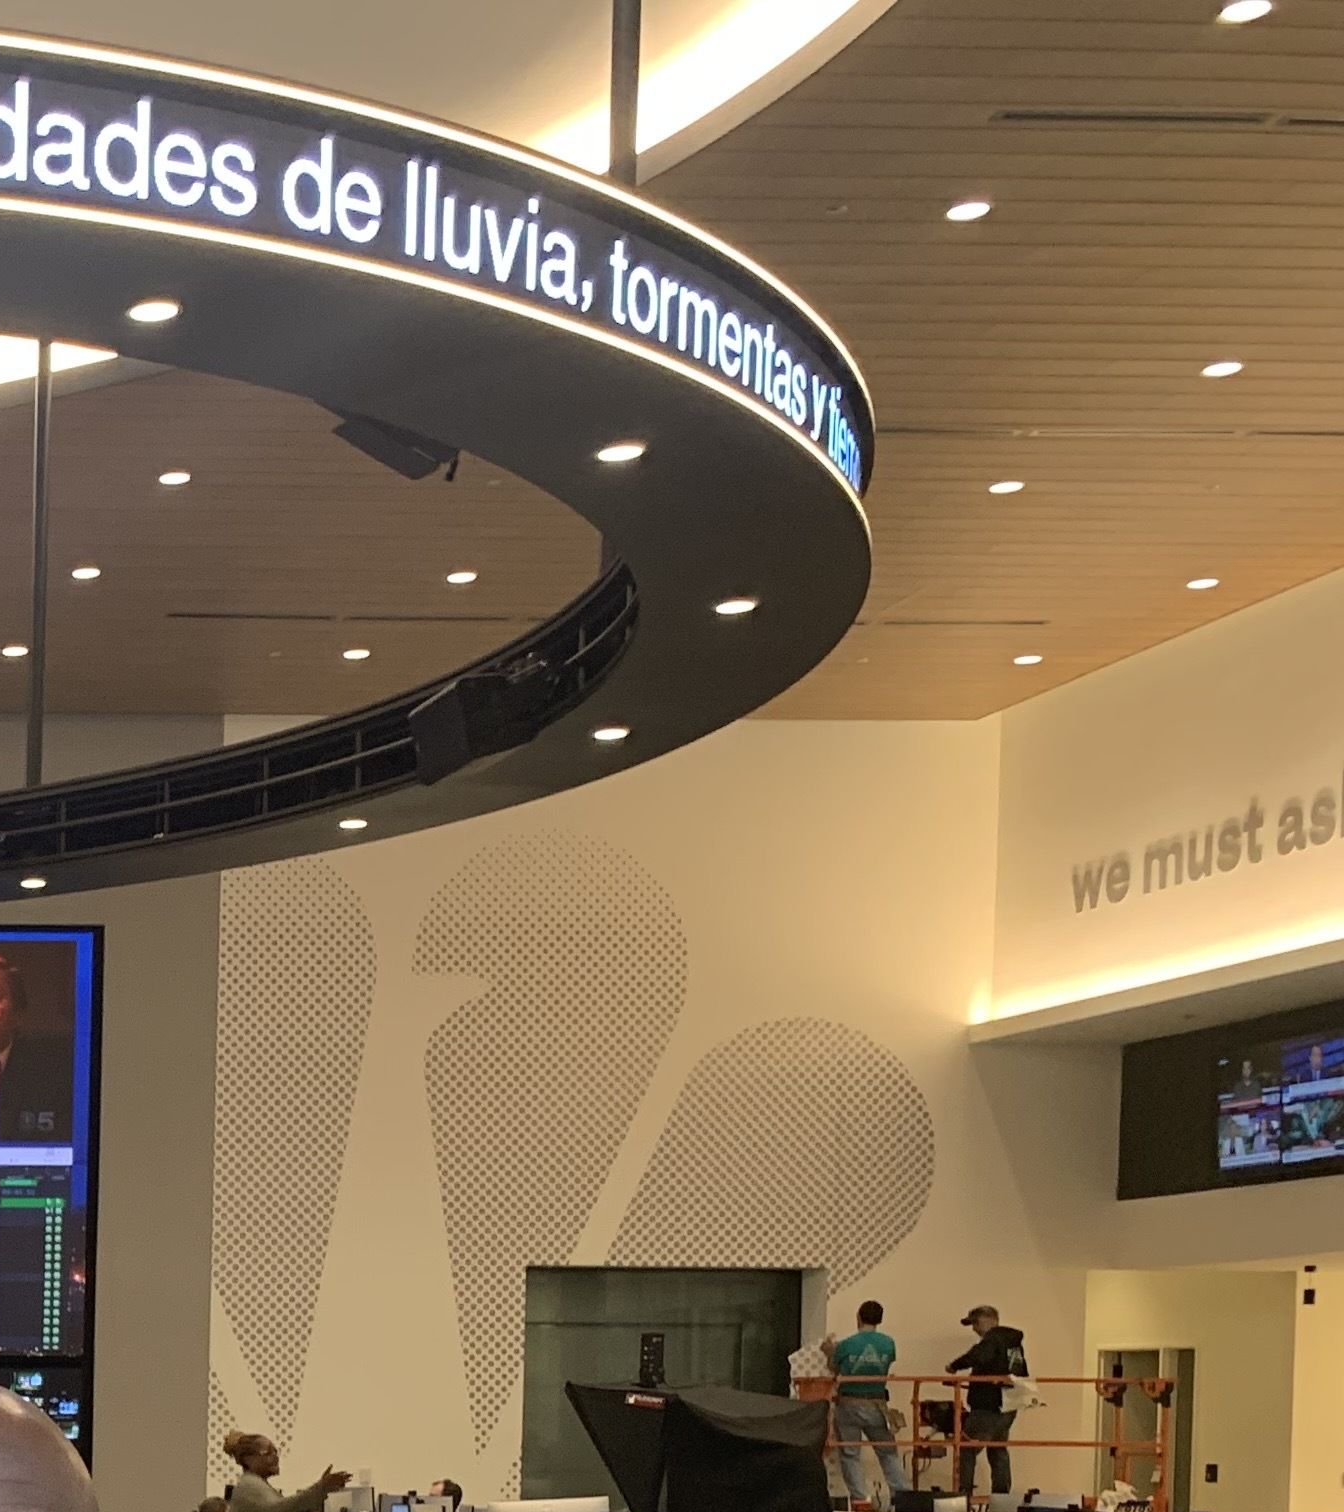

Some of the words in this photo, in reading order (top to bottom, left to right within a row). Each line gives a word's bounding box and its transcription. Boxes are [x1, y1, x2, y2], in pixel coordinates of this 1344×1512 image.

[282, 134, 382, 244] de
[405, 157, 593, 313] lluvia,
[609, 239, 808, 427] tormentas
[811, 374, 828, 442] y
[1072, 856, 1131, 914] we
[1143, 800, 1265, 895] must
[1277, 772, 1344, 857] as
